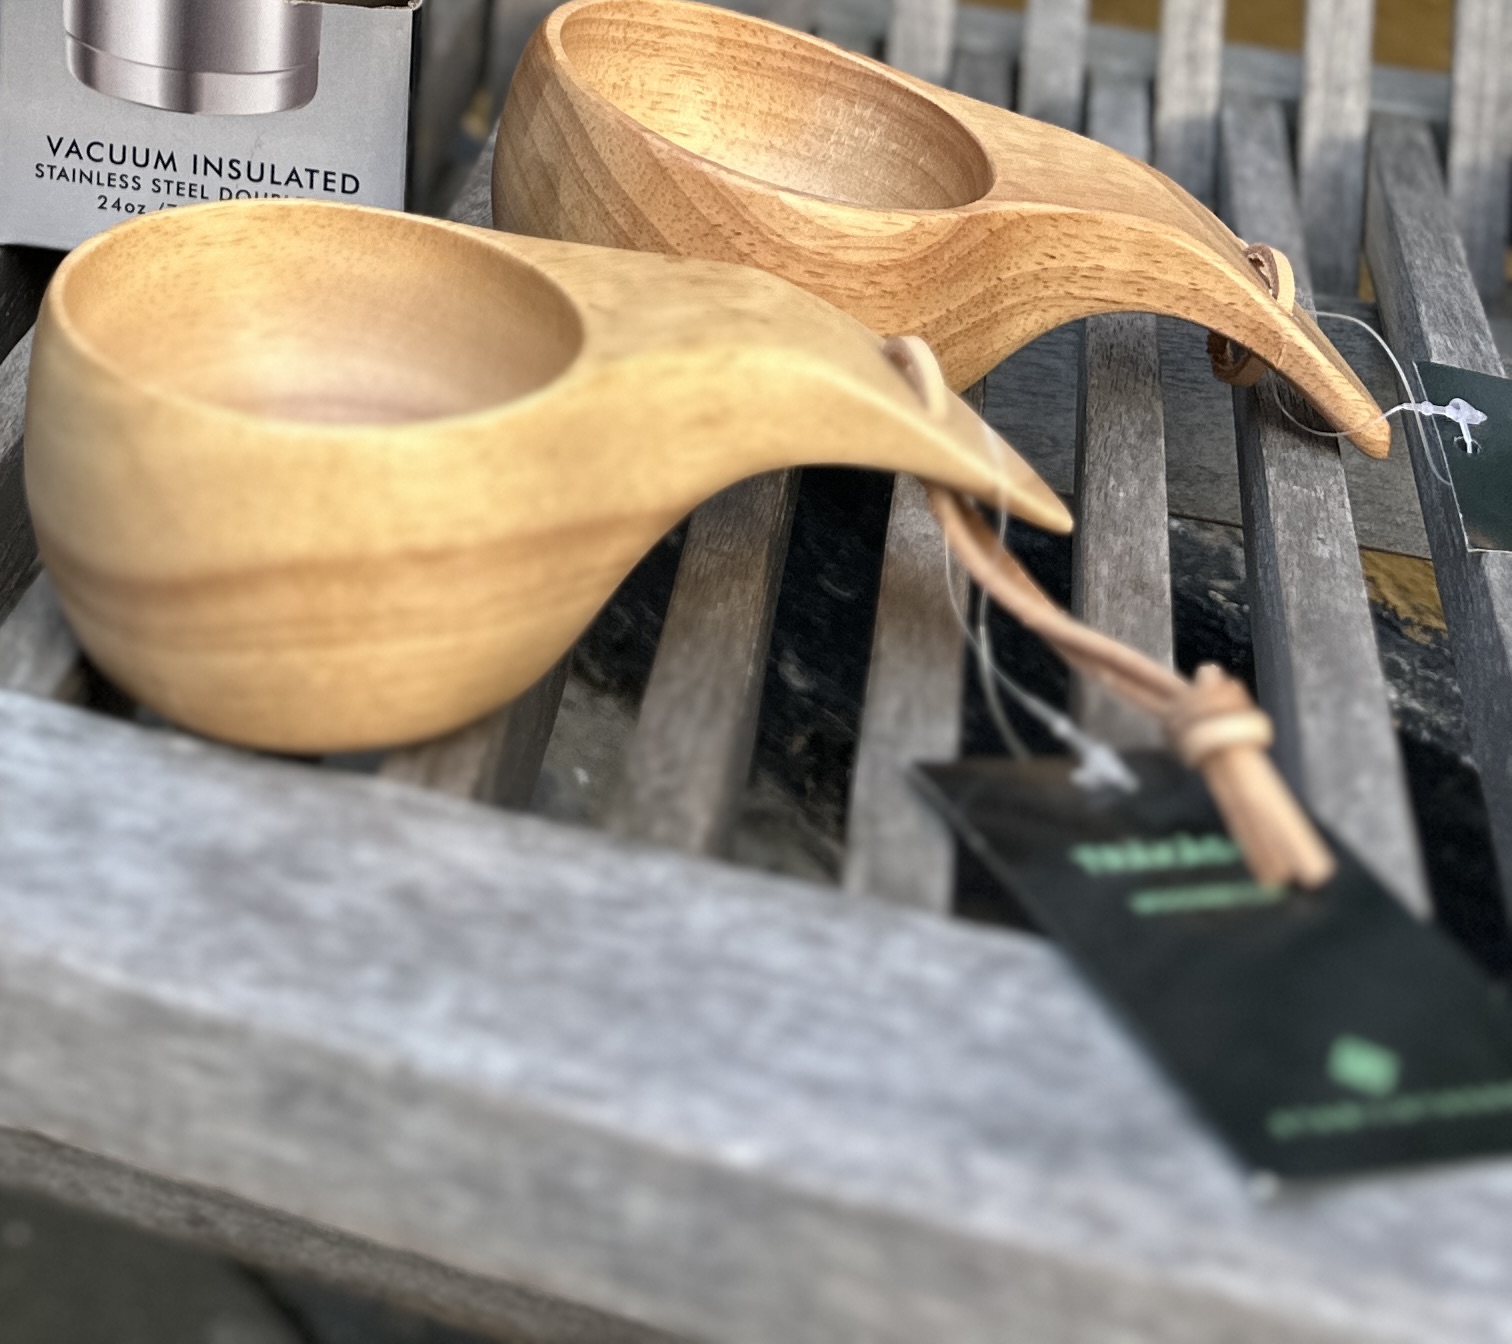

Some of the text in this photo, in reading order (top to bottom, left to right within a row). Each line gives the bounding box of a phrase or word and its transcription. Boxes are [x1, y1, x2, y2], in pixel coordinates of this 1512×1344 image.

[34, 162, 142, 192] STAINLESS
[151, 177, 209, 200] STEEL
[45, 134, 361, 195] VACUUM INSULATED
[97, 194, 146, 215] 24oz
